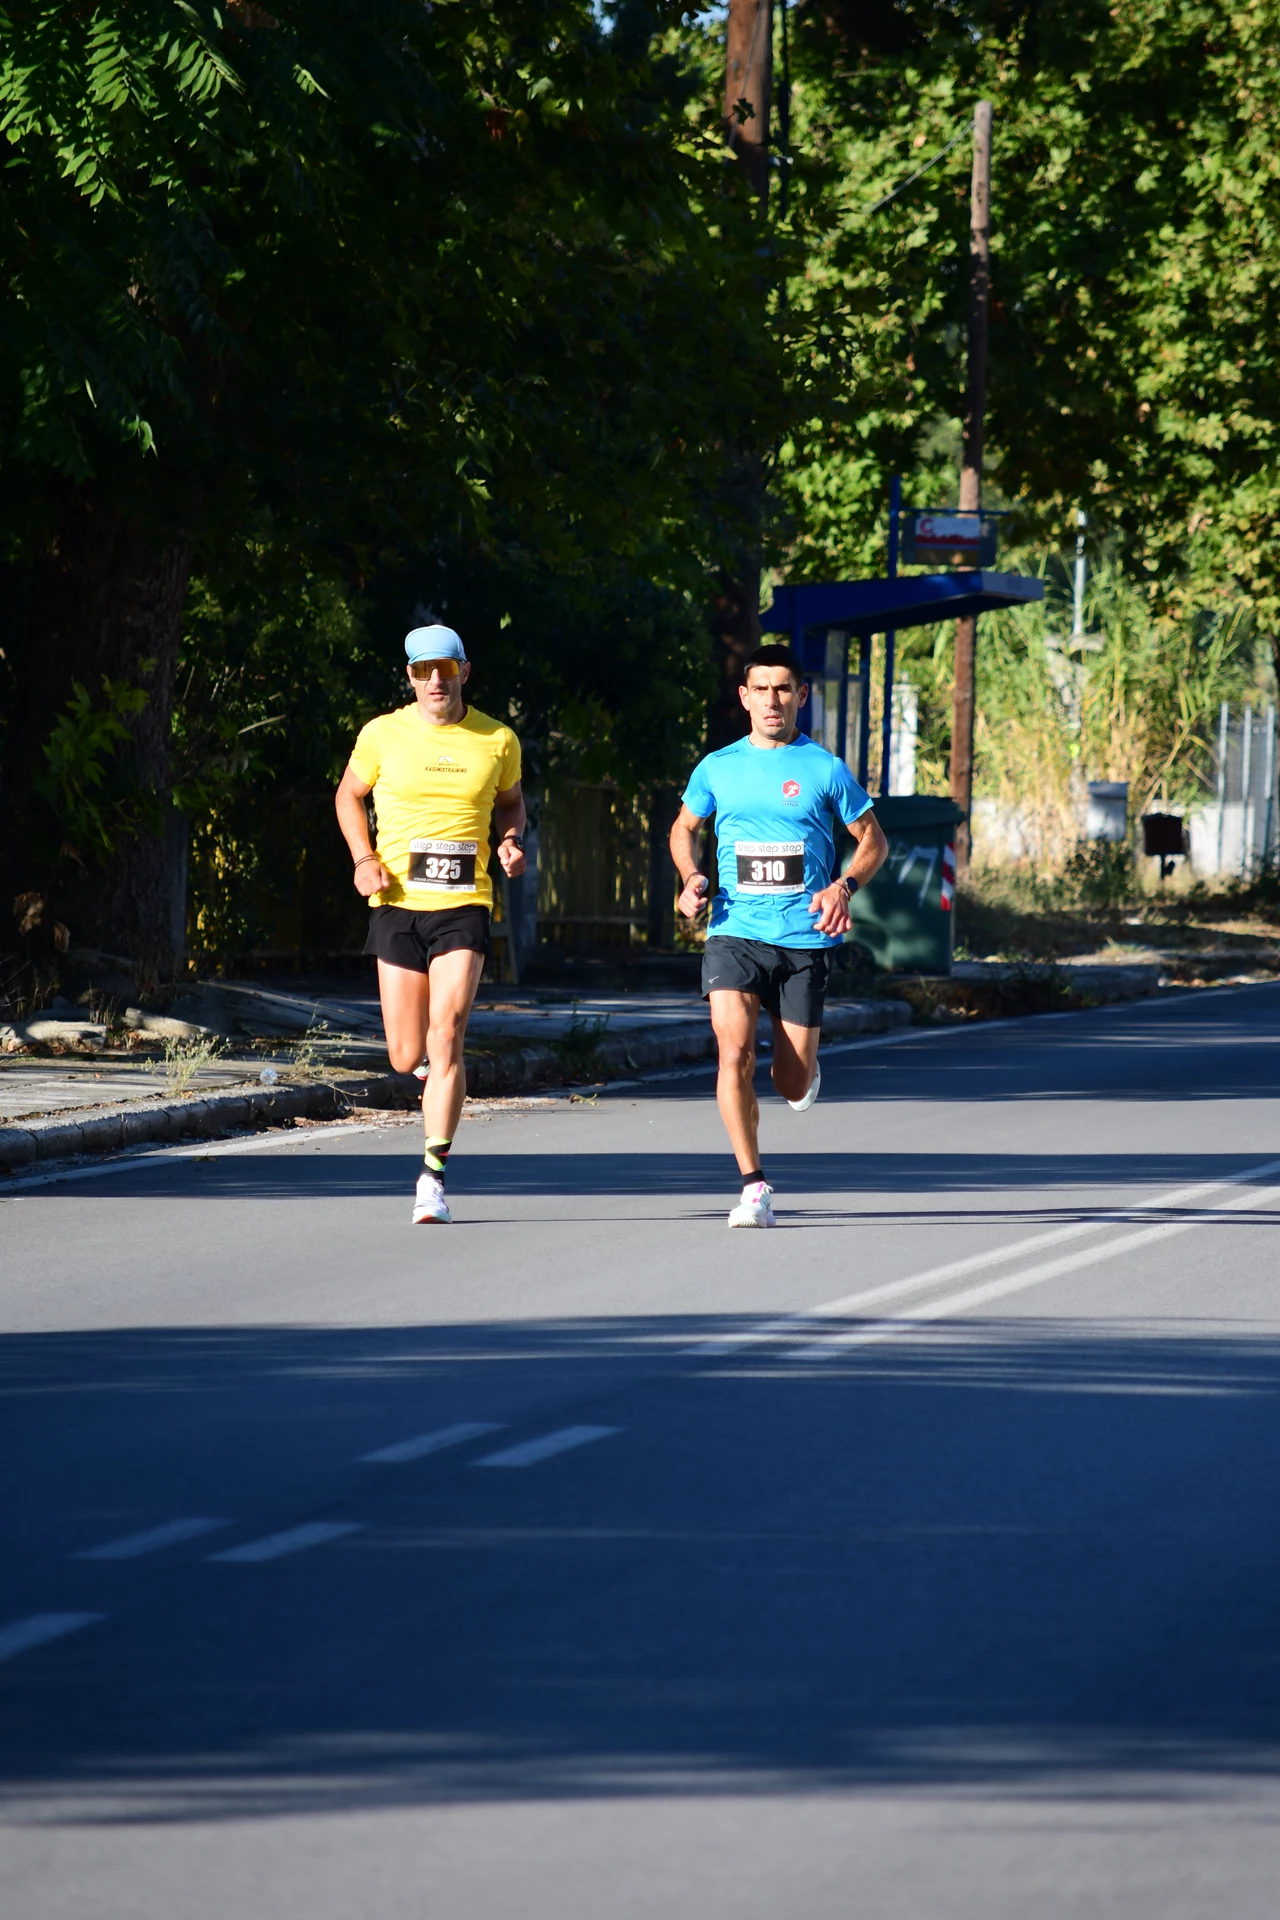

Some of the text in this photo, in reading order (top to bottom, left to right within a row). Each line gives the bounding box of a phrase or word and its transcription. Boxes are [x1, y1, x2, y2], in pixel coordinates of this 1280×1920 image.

[413, 842, 476, 853] step step step
[738, 843, 802, 854] step step step
[426, 857, 460, 879] 325
[751, 860, 785, 881] 310
